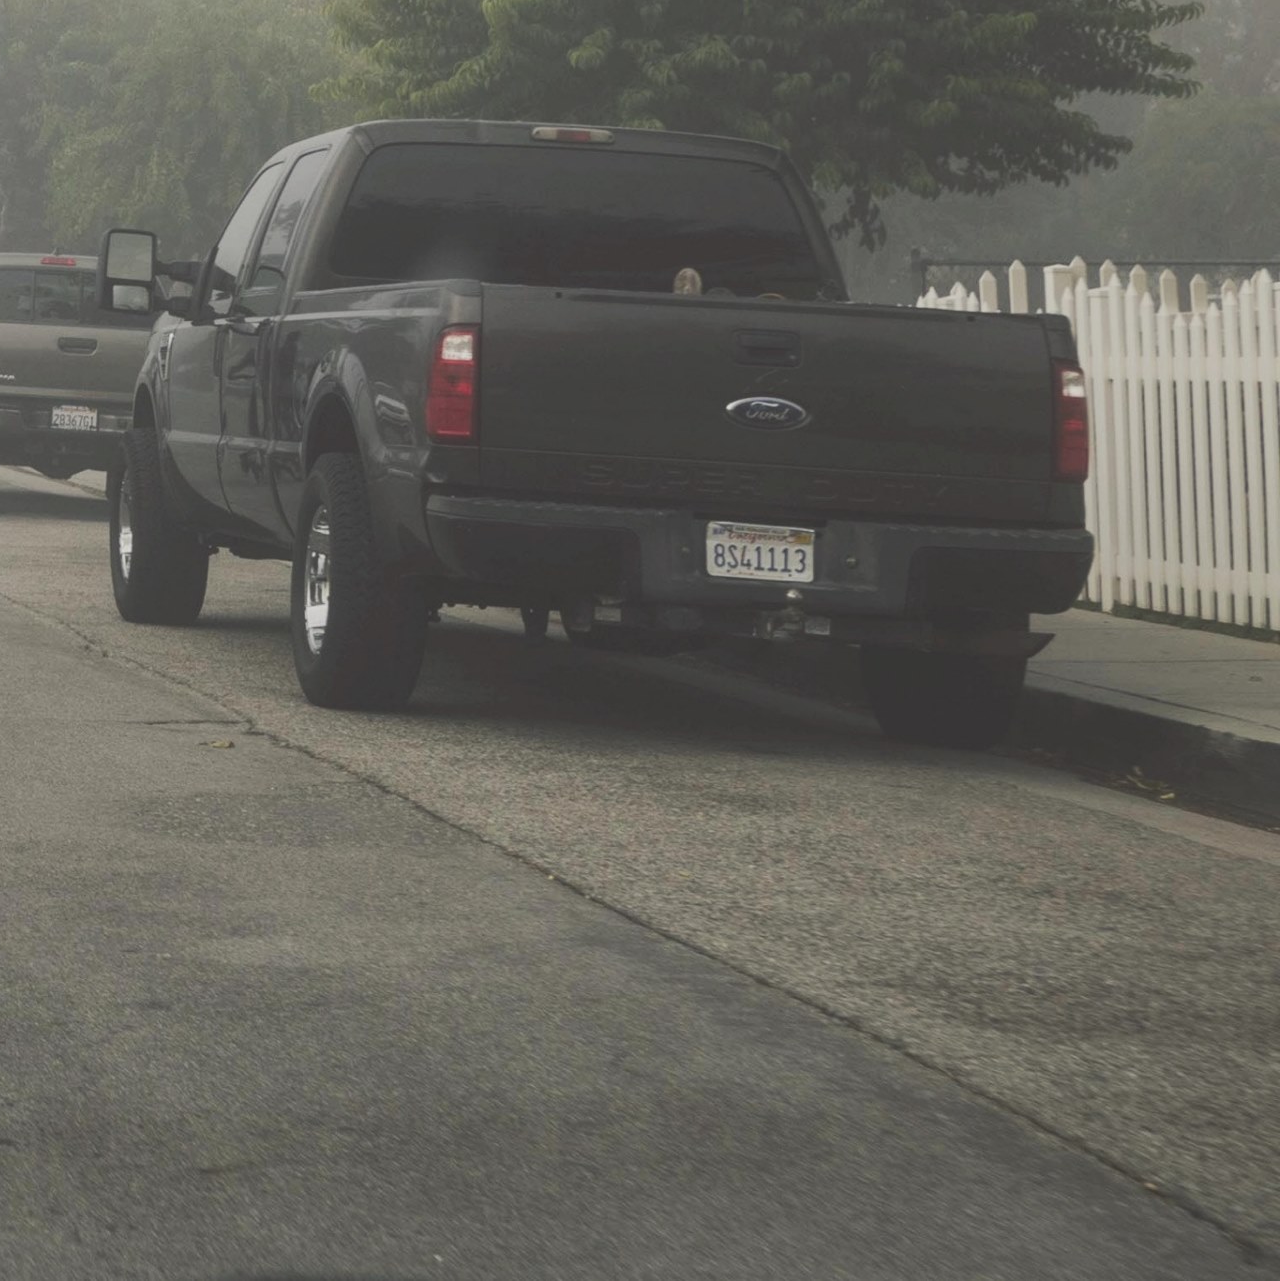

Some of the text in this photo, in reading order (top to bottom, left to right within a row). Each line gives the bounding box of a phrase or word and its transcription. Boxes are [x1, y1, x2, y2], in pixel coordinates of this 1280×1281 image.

[745, 401, 790, 421] Ford
[580, 463, 762, 497] SUPER
[713, 543, 807, 574] 8S41113
